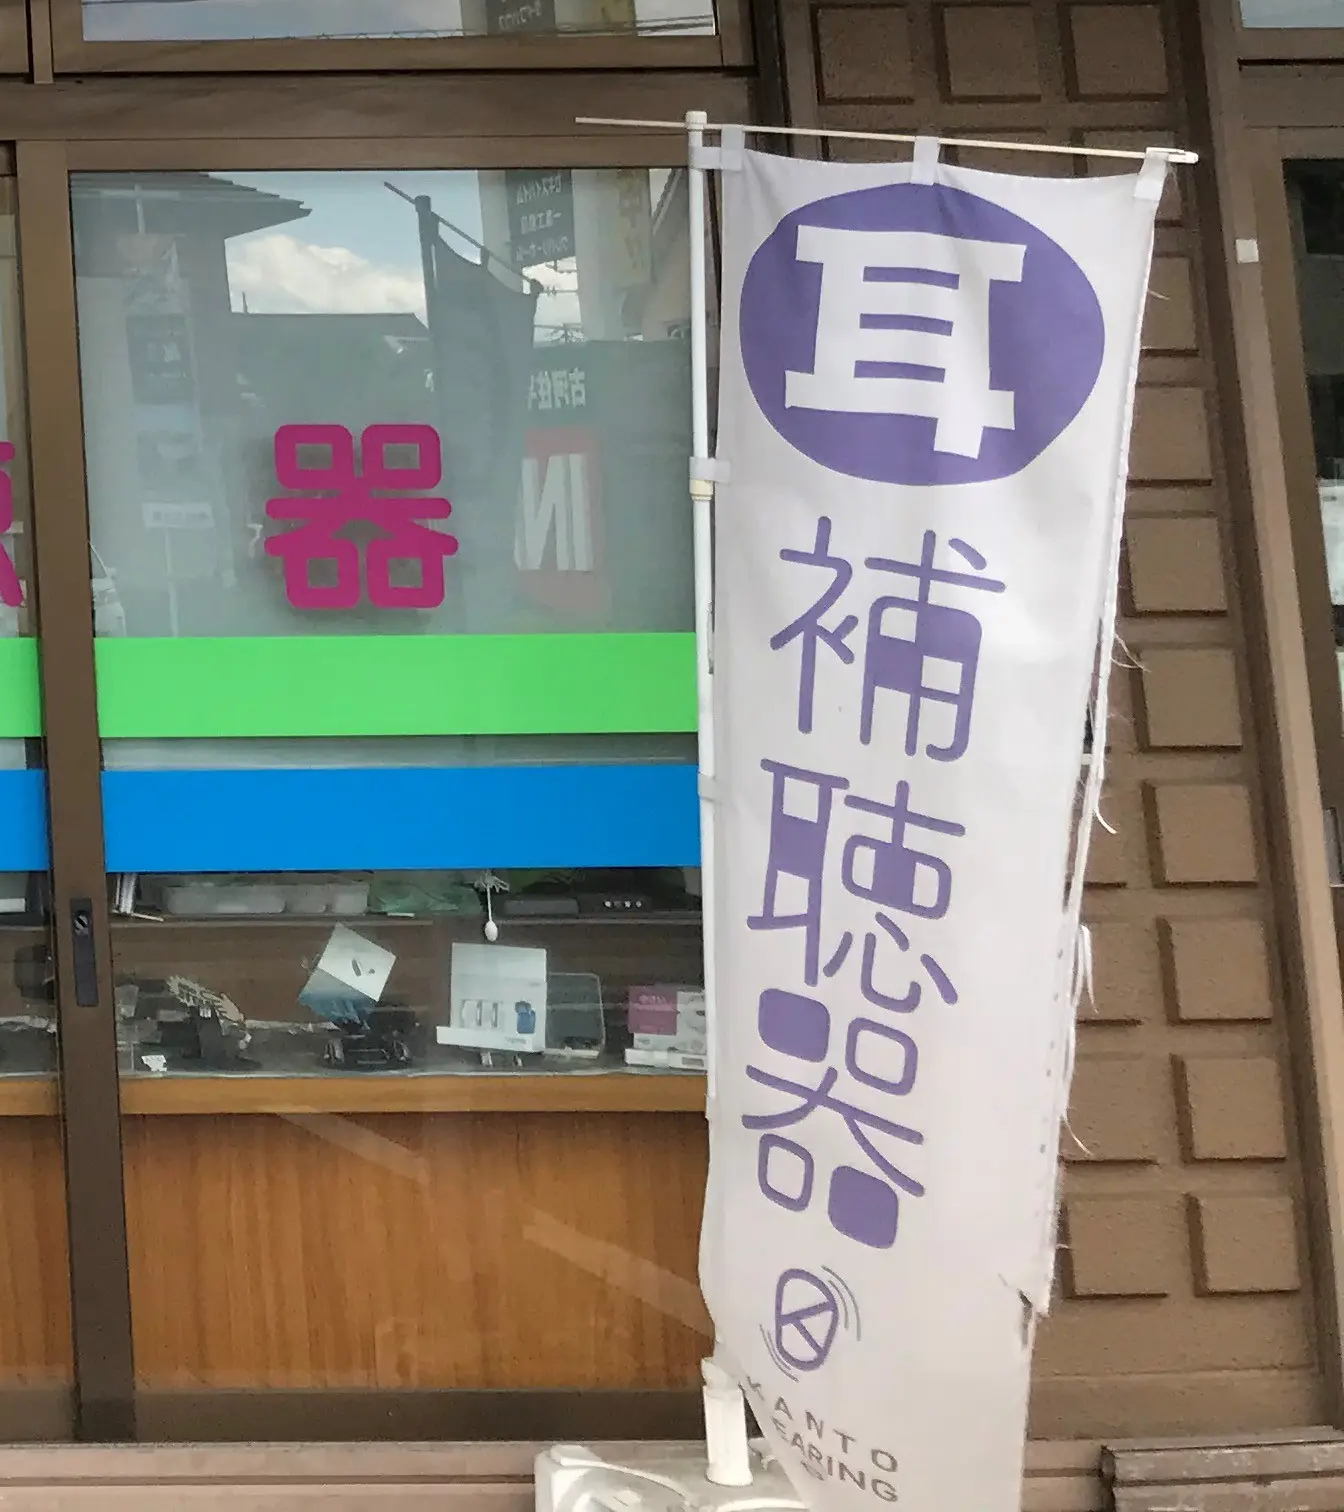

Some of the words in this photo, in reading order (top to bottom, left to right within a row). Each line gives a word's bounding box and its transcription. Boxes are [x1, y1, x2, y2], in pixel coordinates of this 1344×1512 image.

[785, 224, 1026, 459] 耳
[743, 516, 1006, 1250] 補聴器
